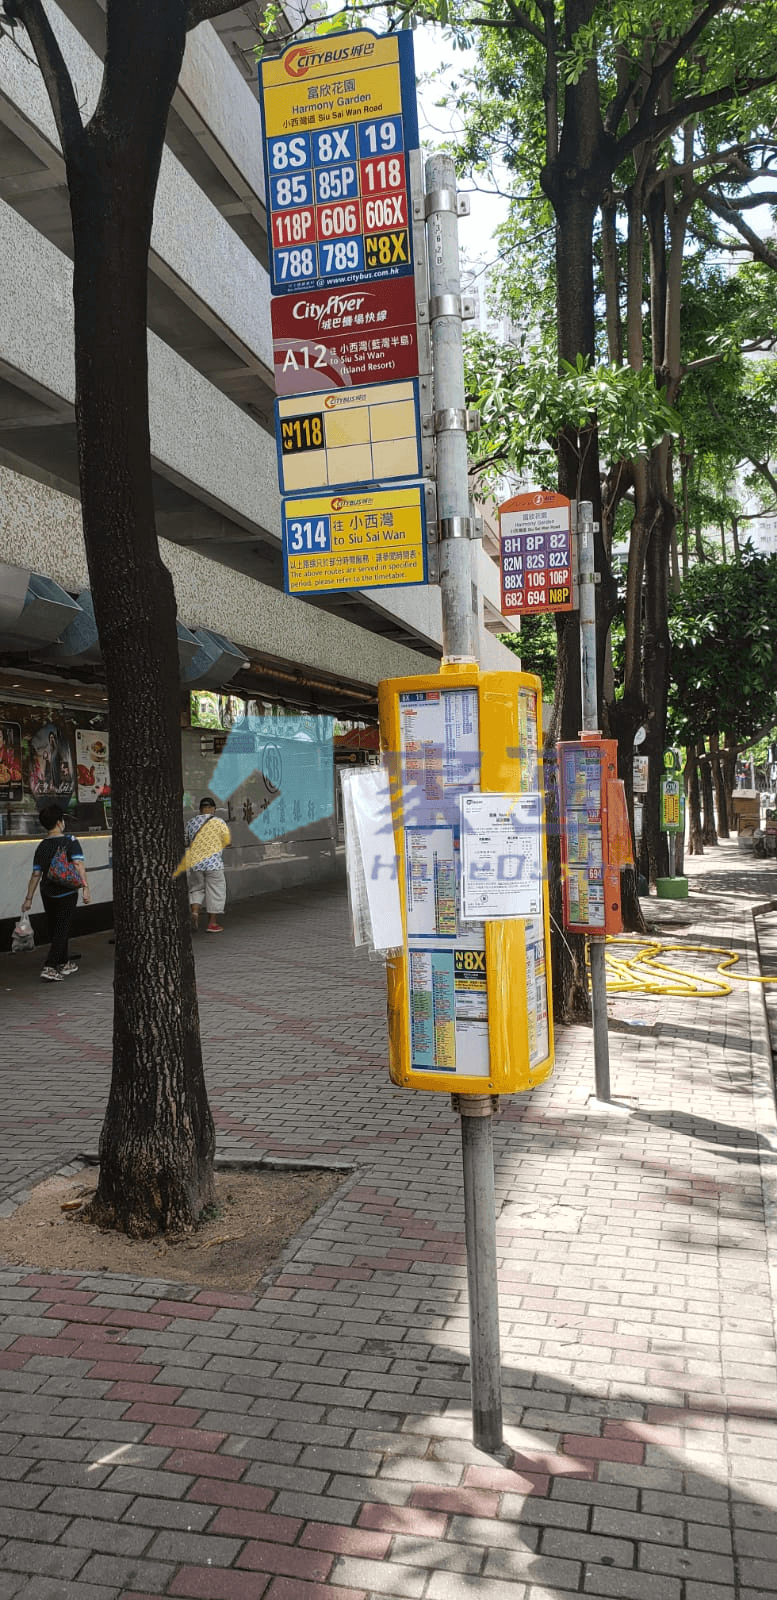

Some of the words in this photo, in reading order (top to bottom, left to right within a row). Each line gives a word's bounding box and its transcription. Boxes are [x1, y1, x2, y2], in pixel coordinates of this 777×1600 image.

[297, 48, 349, 68] CITYBUS
[350, 43, 375, 56] 城巴
[307, 79, 356, 99] 富欣花園
[292, 99, 335, 115] Harmony
[336, 93, 372, 107] Garden
[282, 114, 316, 129] 小西灣道
[318, 112, 331, 122] Siu
[332, 109, 344, 119] Sai
[345, 107, 362, 117] Wan
[363, 103, 383, 113] Road
[272, 137, 307, 170] 8S
[318, 129, 351, 162] 8X
[365, 121, 397, 153] 19
[276, 175, 307, 206] 85
[318, 166, 354, 200] 85P
[365, 158, 401, 191] 118
[275, 211, 312, 243] 118P
[321, 205, 357, 236] 606
[365, 195, 404, 229] 606X
[278, 248, 313, 280] 788
[322, 240, 359, 273] 789
[366, 232, 407, 266] N8X
[326, 267, 400, 286] www.citybus.com.hk
[292, 294, 366, 323] Cityflyer
[320, 309, 388, 331] 城巴機場快線
[282, 344, 328, 373] A12
[329, 347, 337, 356] 往
[330, 357, 339, 365] to
[340, 355, 352, 364] Siu
[354, 353, 366, 362] Sai
[366, 351, 385, 360] Wan
[340, 362, 366, 376] (Island
[368, 359, 396, 372] Resort)
[281, 417, 323, 450] N118
[333, 519, 344, 532] 往
[349, 511, 394, 531] 小西灣
[290, 520, 327, 550] 314
[333, 536, 345, 546] to
[348, 532, 363, 545] Siu
[366, 531, 380, 543] Sai
[382, 529, 406, 541] Wan
[504, 537, 521, 553] 8H
[526, 535, 544, 551] 8P
[550, 533, 566, 549] 82
[290, 570, 302, 579] The
[303, 568, 323, 578] above
[324, 566, 345, 576] routes
[358, 564, 379, 574] served
[388, 561, 417, 572] specified
[504, 556, 522, 572] 82M
[526, 554, 545, 569] 82S
[549, 551, 568, 567] 82X
[314, 577, 334, 587] please
[336, 576, 351, 584] refer
[362, 574, 373, 582] the
[374, 571, 407, 581] timetable.
[504, 573, 522, 589] 88X
[527, 572, 546, 587] 106
[549, 569, 569, 585] 106P
[505, 592, 523, 607] 682
[527, 590, 546, 605] 694
[549, 587, 569, 603] N8P
[455, 951, 486, 970] N8X
